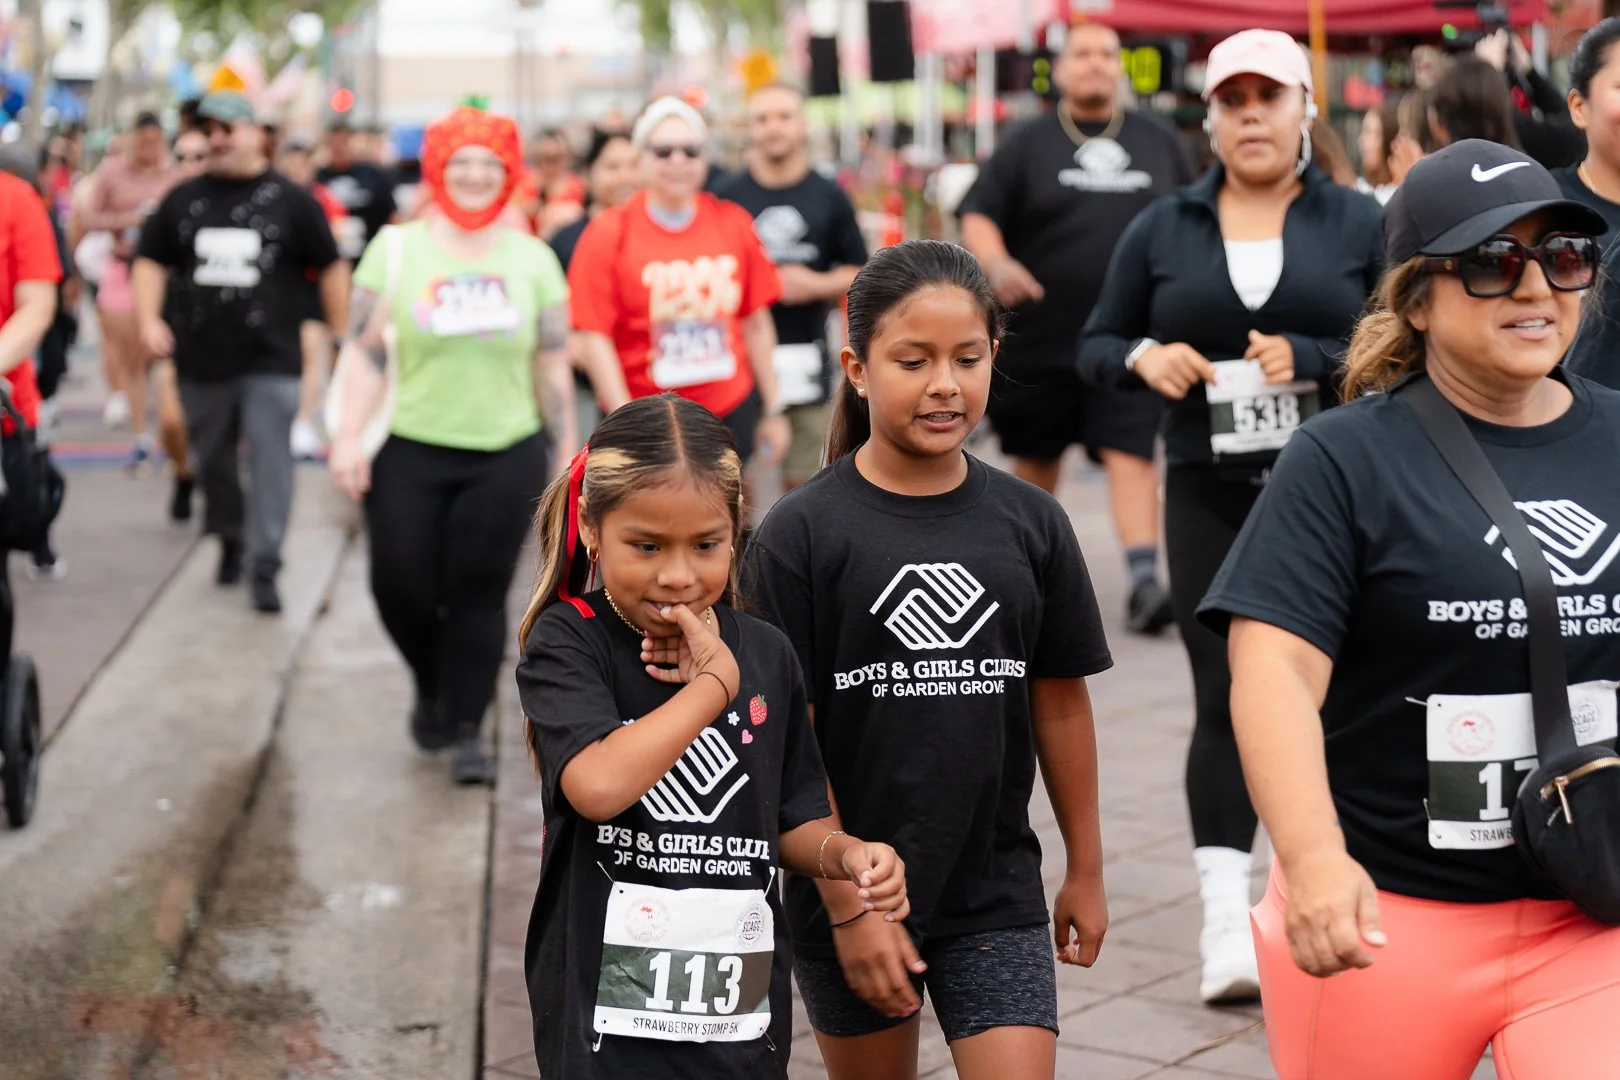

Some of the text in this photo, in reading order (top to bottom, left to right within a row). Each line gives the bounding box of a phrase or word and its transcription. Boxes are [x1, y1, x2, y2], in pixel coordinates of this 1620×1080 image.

[1232, 394, 1300, 432] 538
[1427, 599, 1504, 622] BOYS
[1556, 594, 1607, 618] RLS
[1475, 623, 1503, 639] OF
[834, 662, 886, 690] BOYS
[891, 661, 910, 680] &
[913, 659, 975, 679] GIRLS
[872, 680, 1005, 698] OF GARDEN GROVE
[636, 832, 655, 853] &
[658, 833, 724, 856] GIRLS
[636, 854, 701, 874] GARDEN
[704, 860, 752, 876] GROVE
[645, 951, 743, 1015] 113
[633, 1017, 739, 1036] STRAWBERRY STOMP 5K
